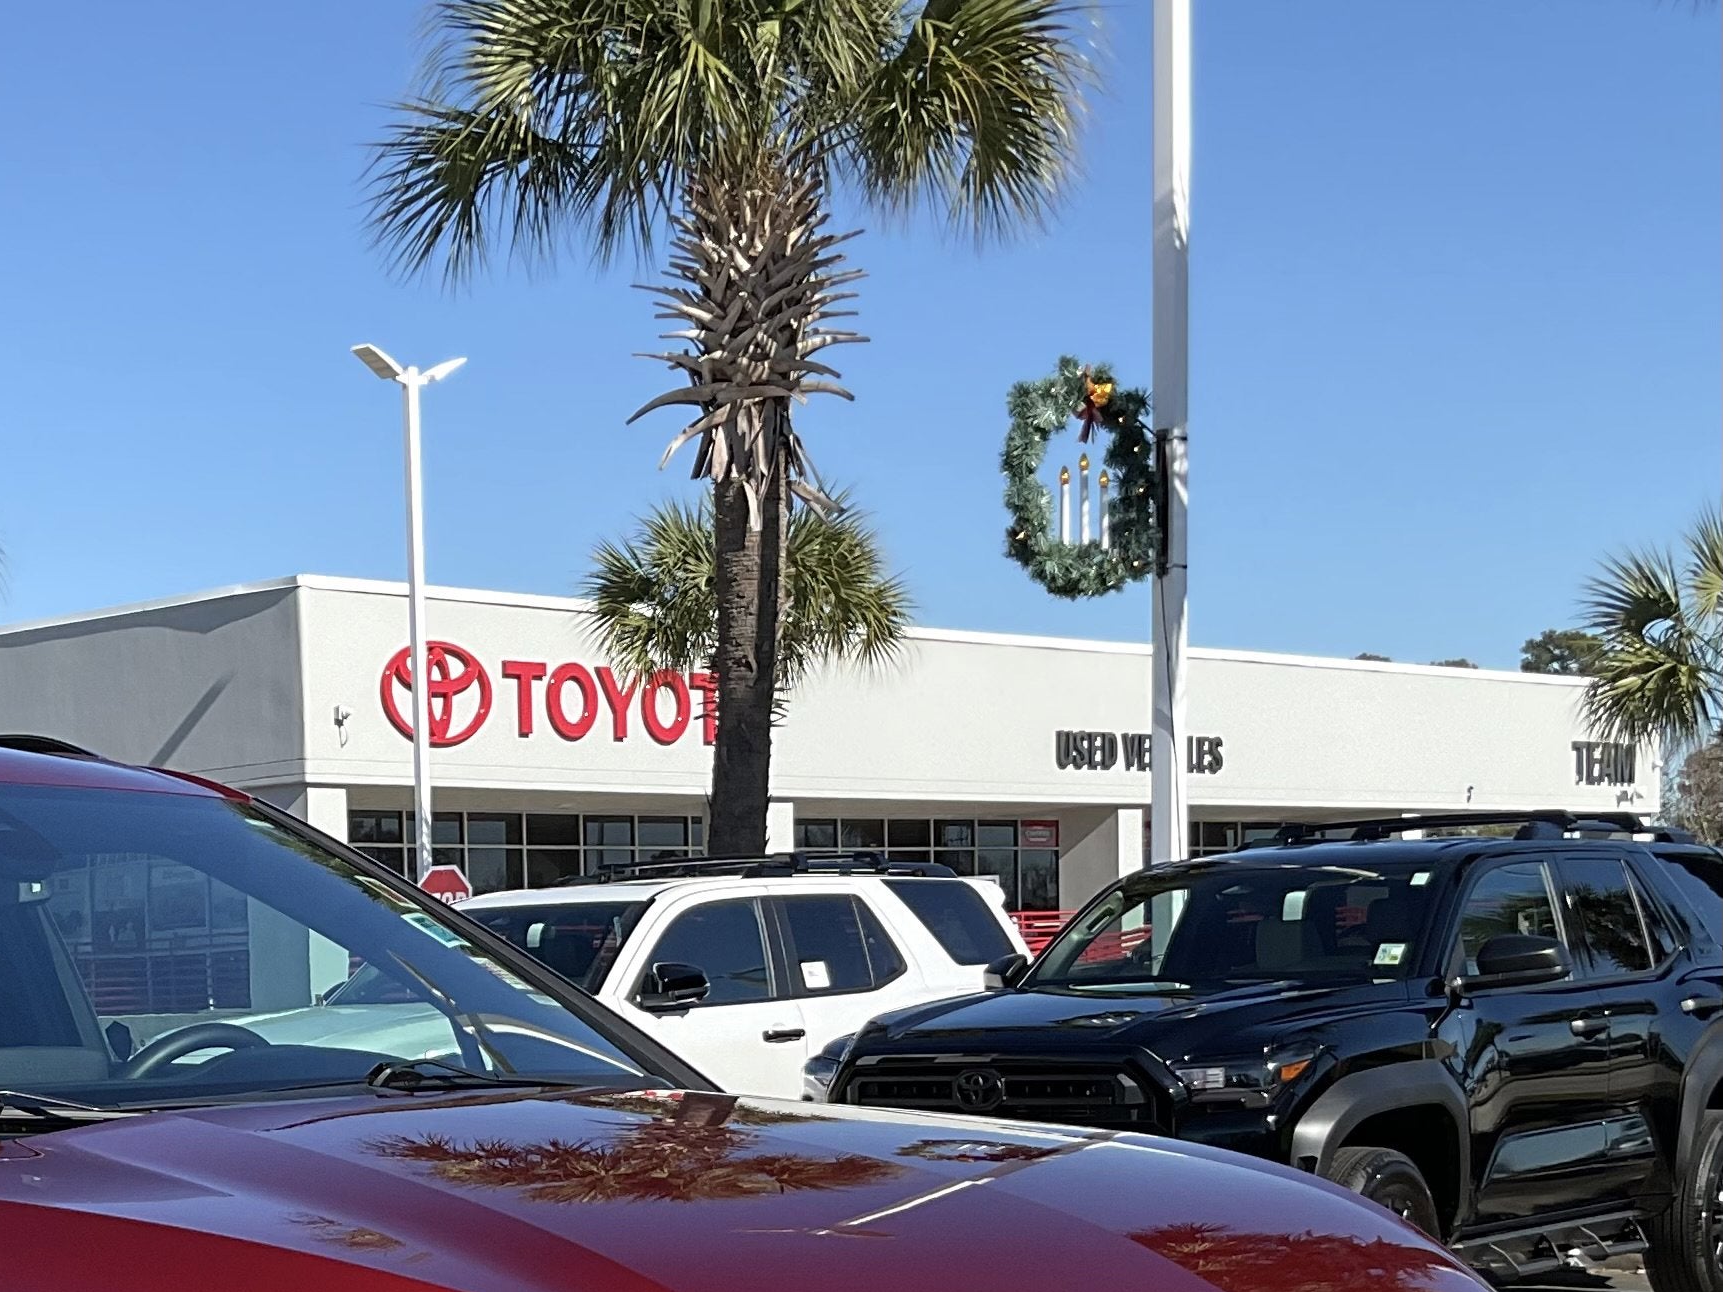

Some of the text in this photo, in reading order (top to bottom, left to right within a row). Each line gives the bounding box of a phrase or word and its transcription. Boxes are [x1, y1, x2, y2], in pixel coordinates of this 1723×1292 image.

[502, 660, 719, 746] TOYOT
[1055, 730, 1223, 774] USED VELES
[1571, 741, 1636, 787] TEAM
